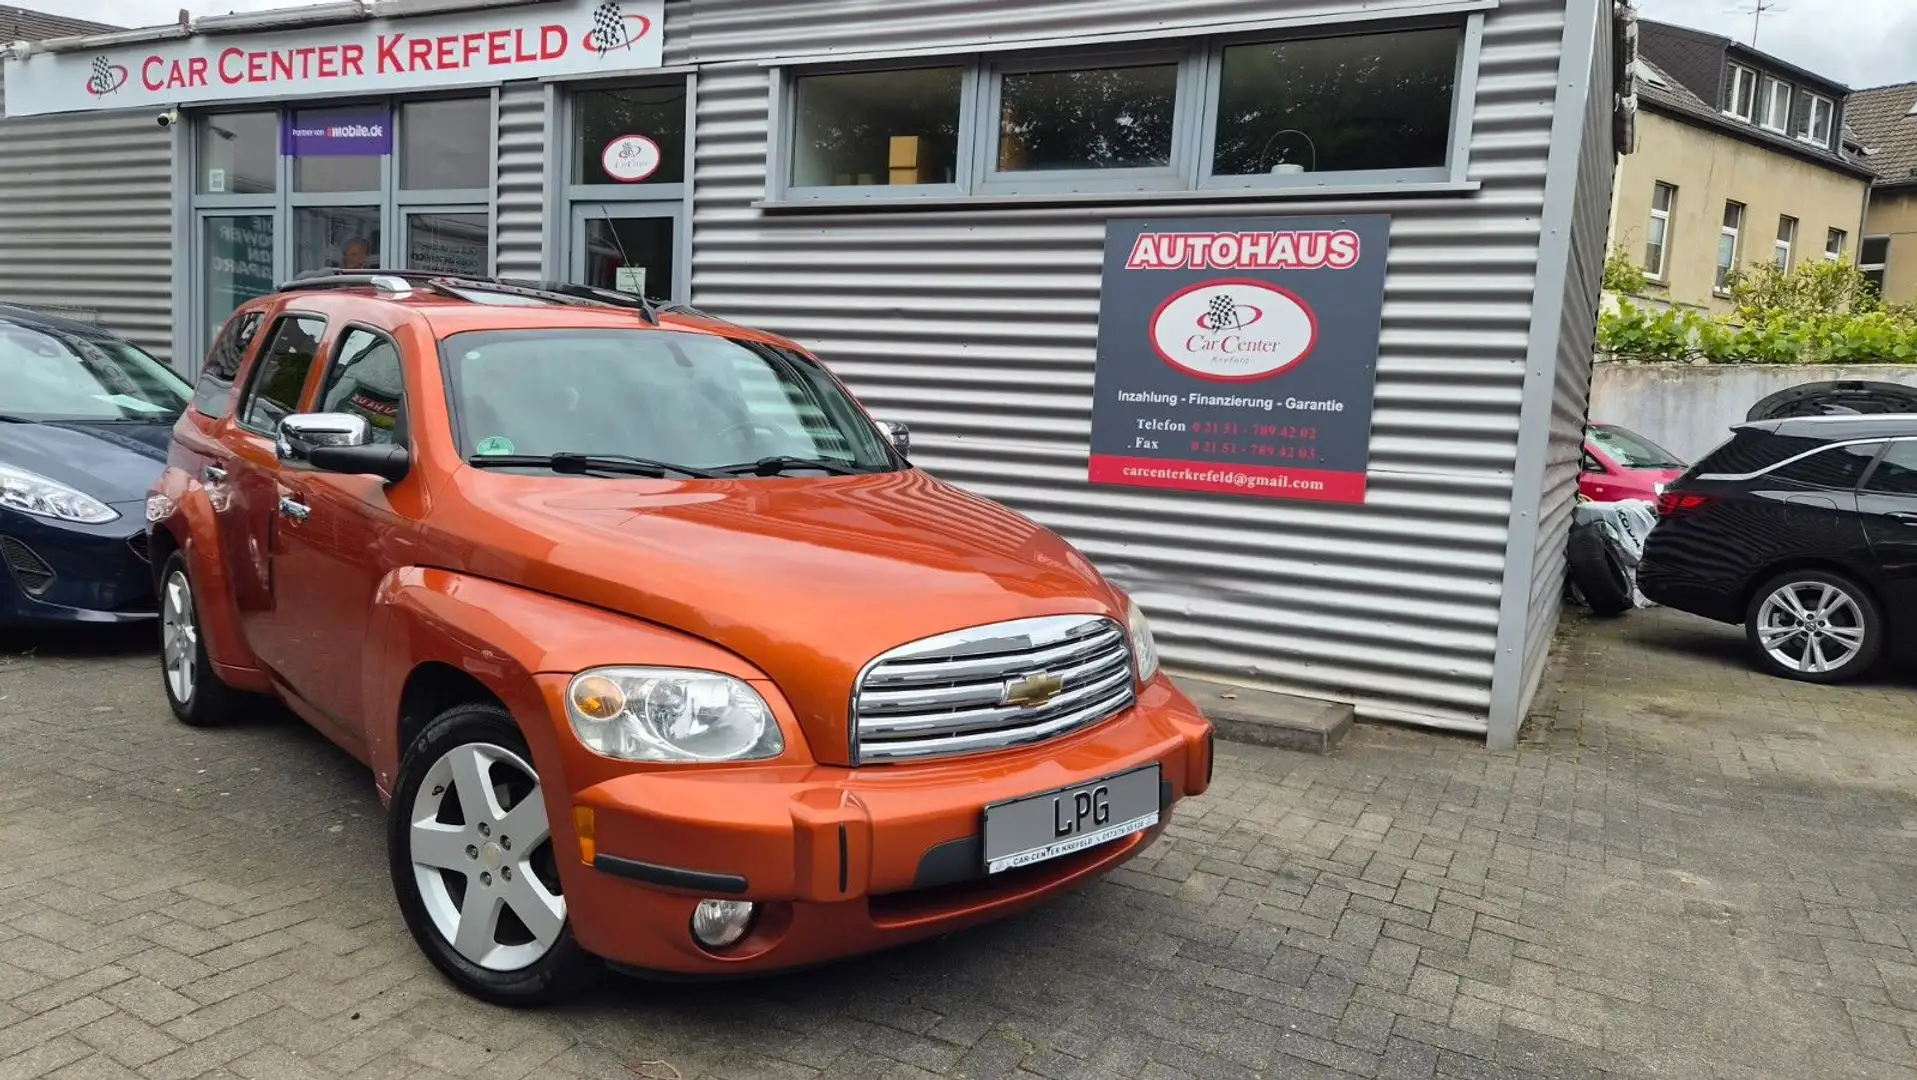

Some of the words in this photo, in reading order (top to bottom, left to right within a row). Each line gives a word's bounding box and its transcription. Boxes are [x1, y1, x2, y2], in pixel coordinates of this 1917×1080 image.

[142, 55, 208, 92] CAR
[218, 44, 364, 85] CENTER
[377, 24, 568, 74] KREFELD
[292, 128, 313, 137] Partner
[314, 129, 325, 137] von
[332, 124, 383, 137] mobile.de
[1126, 230, 1359, 269] AUTOHAUS
[1186, 334, 1219, 352] Car
[1221, 335, 1280, 354] Center
[1118, 390, 1178, 406] Inzahlung
[1189, 393, 1273, 411] Finanzierung
[1285, 397, 1344, 412] Garantie
[1137, 418, 1187, 432] Telefon
[1192, 422, 1200, 432] 0
[1204, 422, 1219, 434] 21
[1223, 423, 1238, 435] 51
[1280, 426, 1297, 439] 42
[1300, 427, 1317, 440] 02
[1135, 437, 1160, 450] Fax
[1123, 465, 1324, 491] carcenterkrefeld@gmail.com
[1053, 785, 1109, 838] LPG
